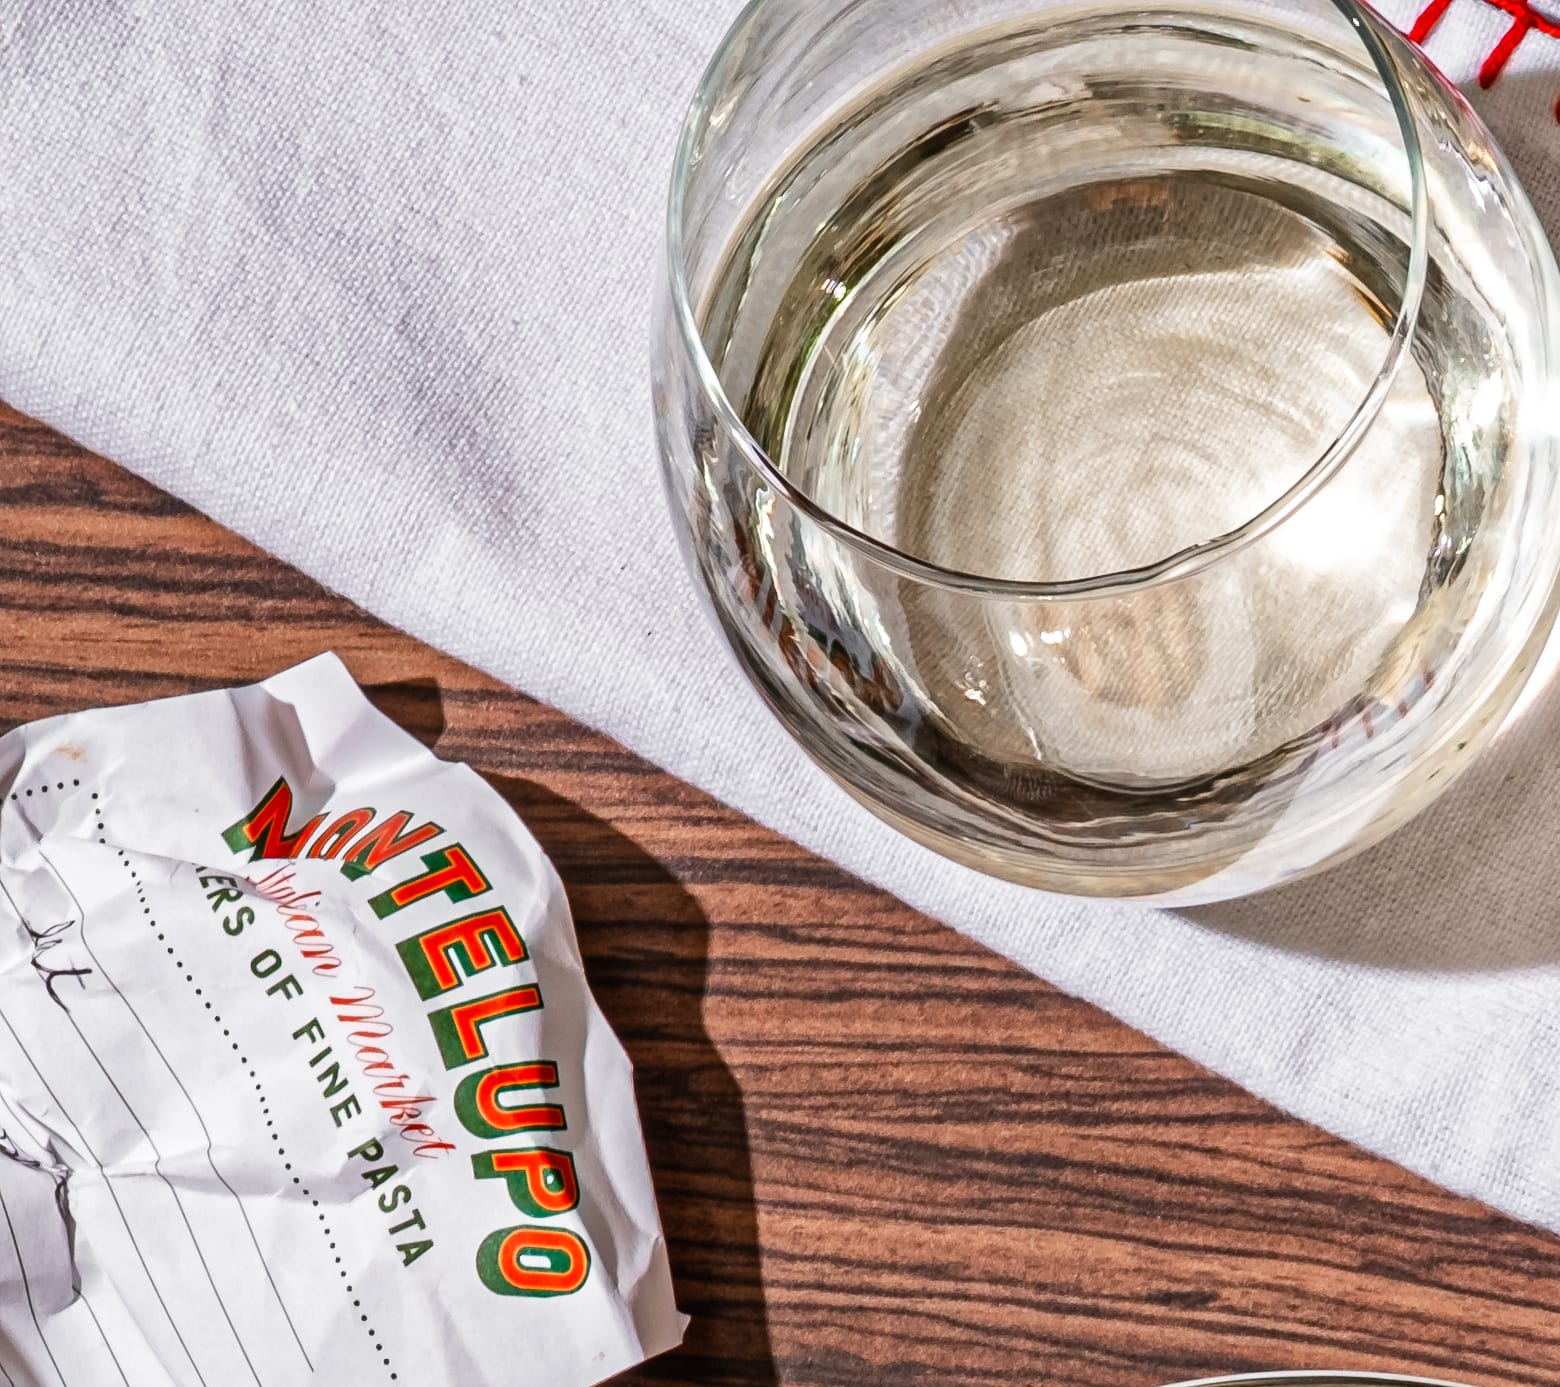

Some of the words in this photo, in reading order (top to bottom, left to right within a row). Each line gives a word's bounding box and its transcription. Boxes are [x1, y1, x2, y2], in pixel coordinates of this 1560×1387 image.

[250, 948, 304, 1000] OF
[292, 1017, 363, 1128] FINE
[346, 1137, 437, 1268] PASTA
[329, 986, 456, 1160] Market
